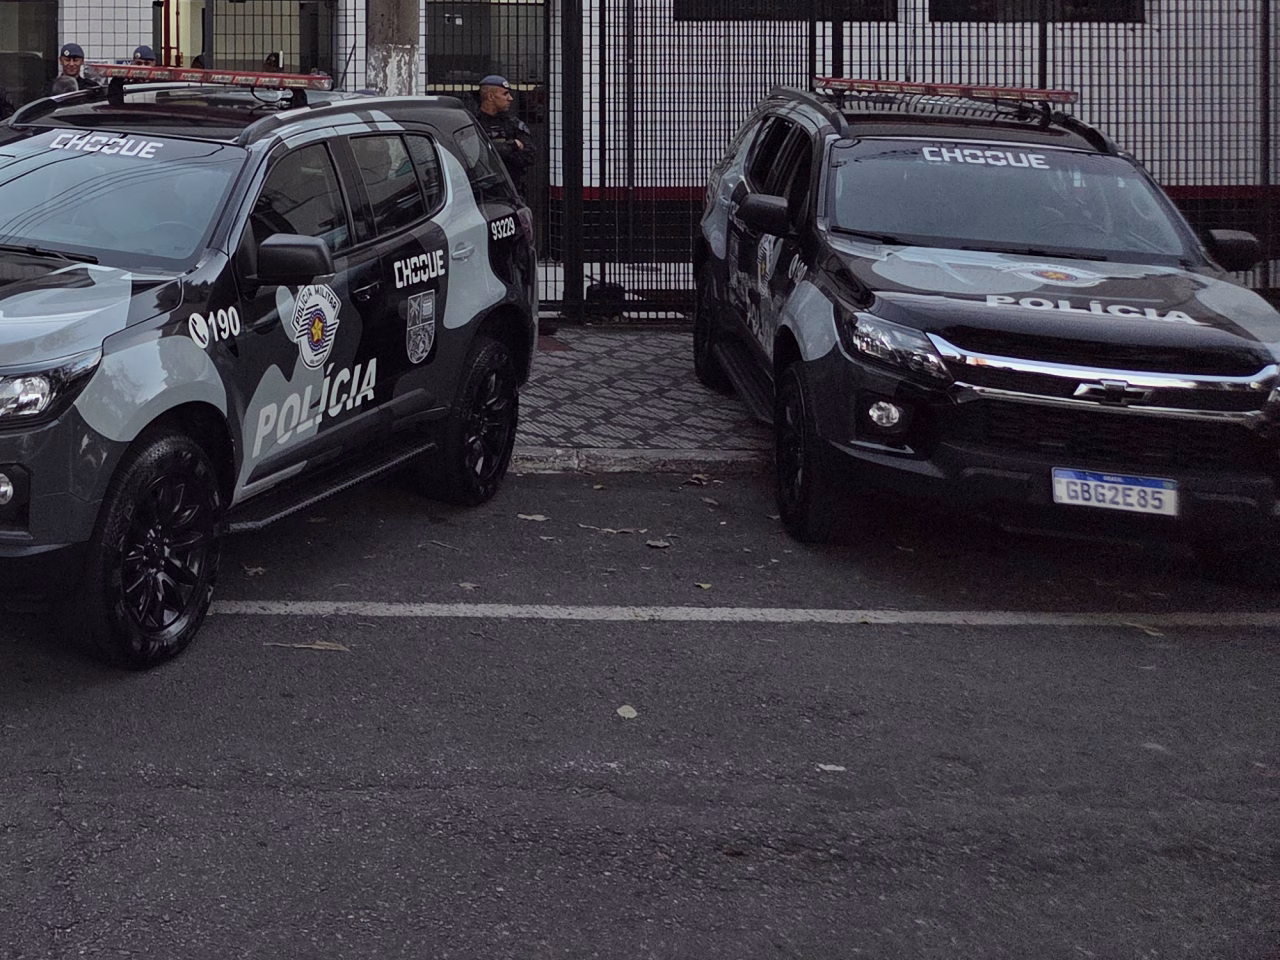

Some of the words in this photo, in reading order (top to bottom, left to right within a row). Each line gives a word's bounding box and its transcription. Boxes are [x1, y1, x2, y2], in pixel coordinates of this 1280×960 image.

[49, 133, 164, 159] CHOQUE
[922, 146, 1050, 169] CHOQUE
[491, 216, 516, 240] 93229
[393, 249, 446, 289] CHOQUE
[314, 285, 338, 311] MILITAR
[986, 294, 1212, 326] POLÍCIA
[208, 306, 240, 342] 190
[252, 357, 377, 458] POLÍCIA
[1065, 480, 1163, 510] GBG2E85
